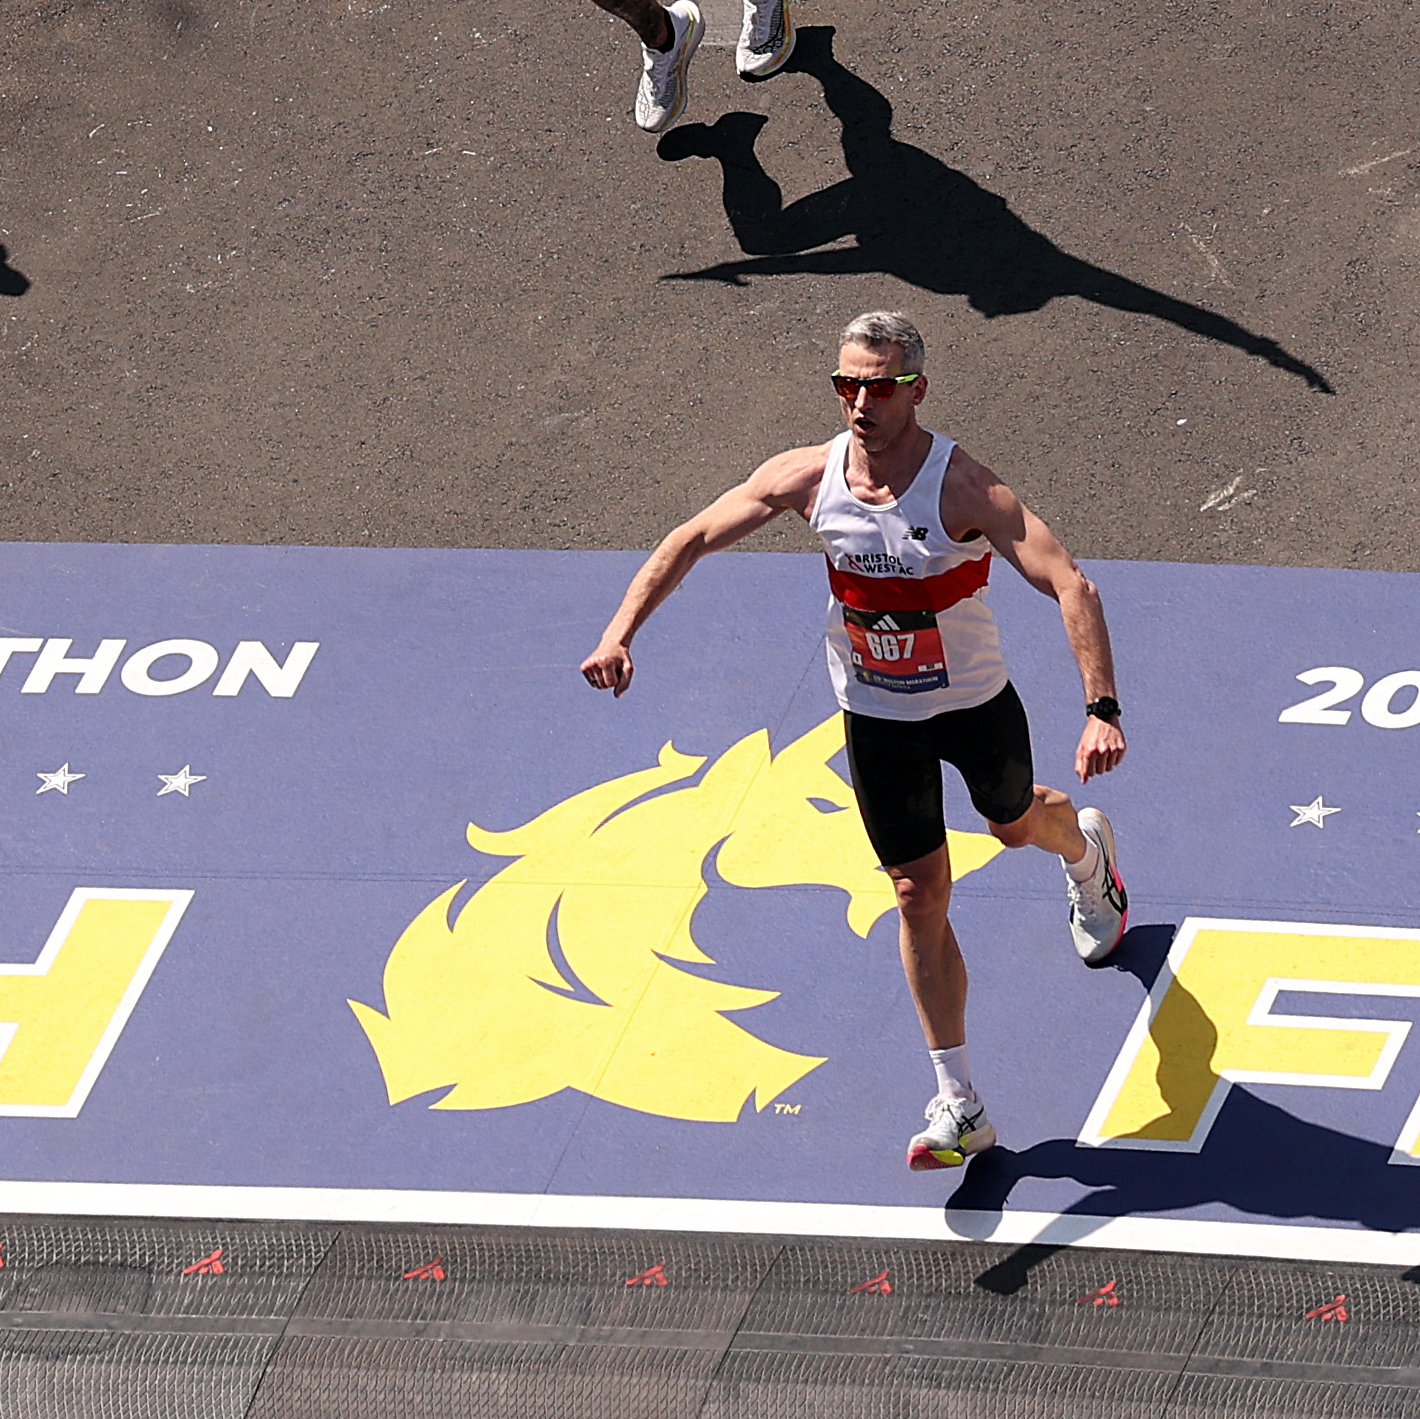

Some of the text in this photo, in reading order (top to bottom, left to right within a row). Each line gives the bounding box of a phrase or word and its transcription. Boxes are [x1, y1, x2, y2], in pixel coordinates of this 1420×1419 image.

[855, 553, 903, 566] BRISTOL
[864, 564, 914, 576] WEST AC
[865, 632, 915, 662] 667
[1075, 917, 1420, 1165] F
[774, 1103, 802, 1115] TM
